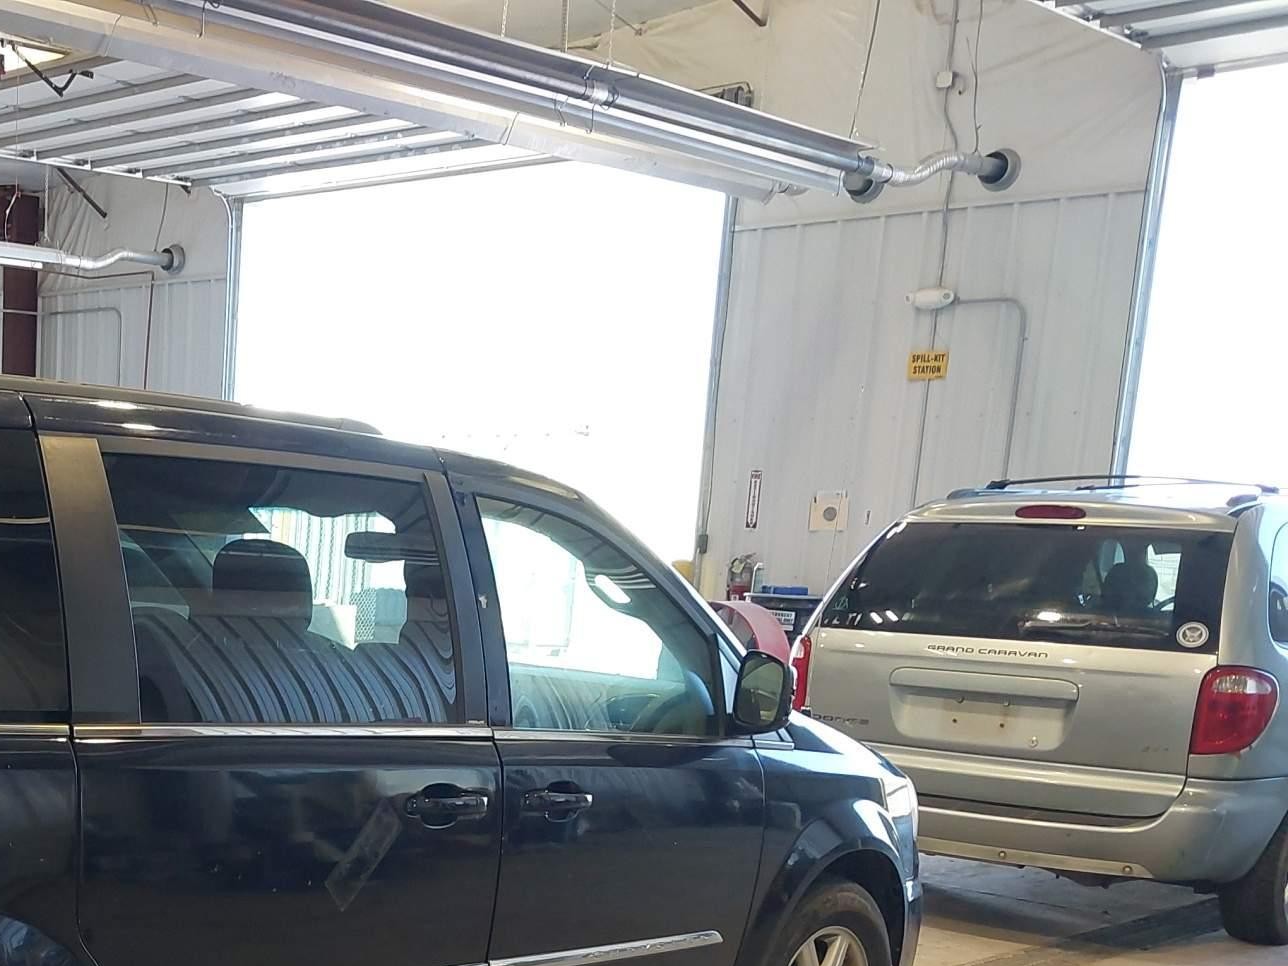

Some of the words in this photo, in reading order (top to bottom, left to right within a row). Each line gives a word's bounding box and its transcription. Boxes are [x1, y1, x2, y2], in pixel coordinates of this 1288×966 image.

[912, 353, 945, 363] SPILL-KIT
[912, 365, 942, 375] STATION
[927, 644, 974, 654] GRAND
[978, 647, 1048, 658] CARAVAN
